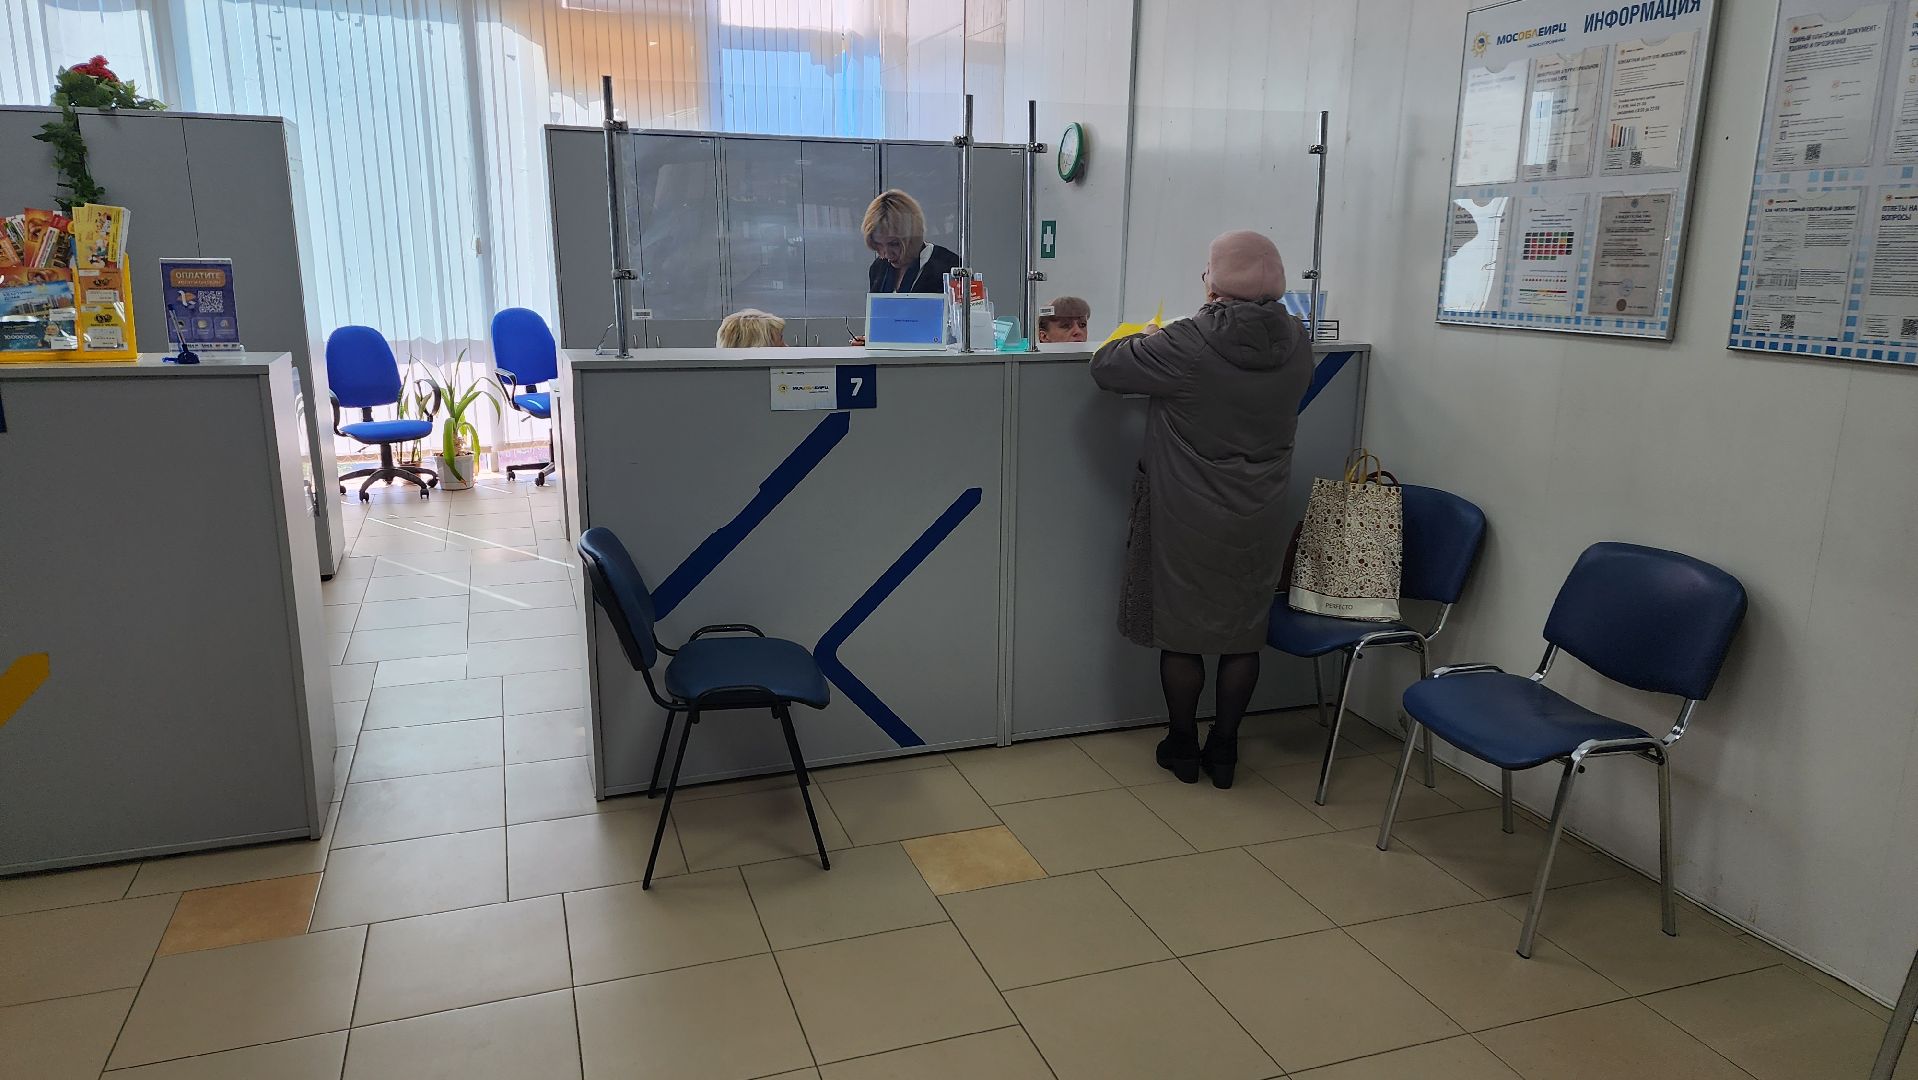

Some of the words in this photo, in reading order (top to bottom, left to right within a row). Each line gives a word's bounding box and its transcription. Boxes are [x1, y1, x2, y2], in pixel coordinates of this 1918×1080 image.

[1583, 0, 1701, 33] ИНФОРМАЦИЯ
[1496, 22, 1567, 46] МОСОБЛЕИРЦ
[175, 271, 221, 279] ОПЛАТИТЕ
[850, 377, 863, 397] 7
[1325, 602, 1353, 610] PERFECTO
